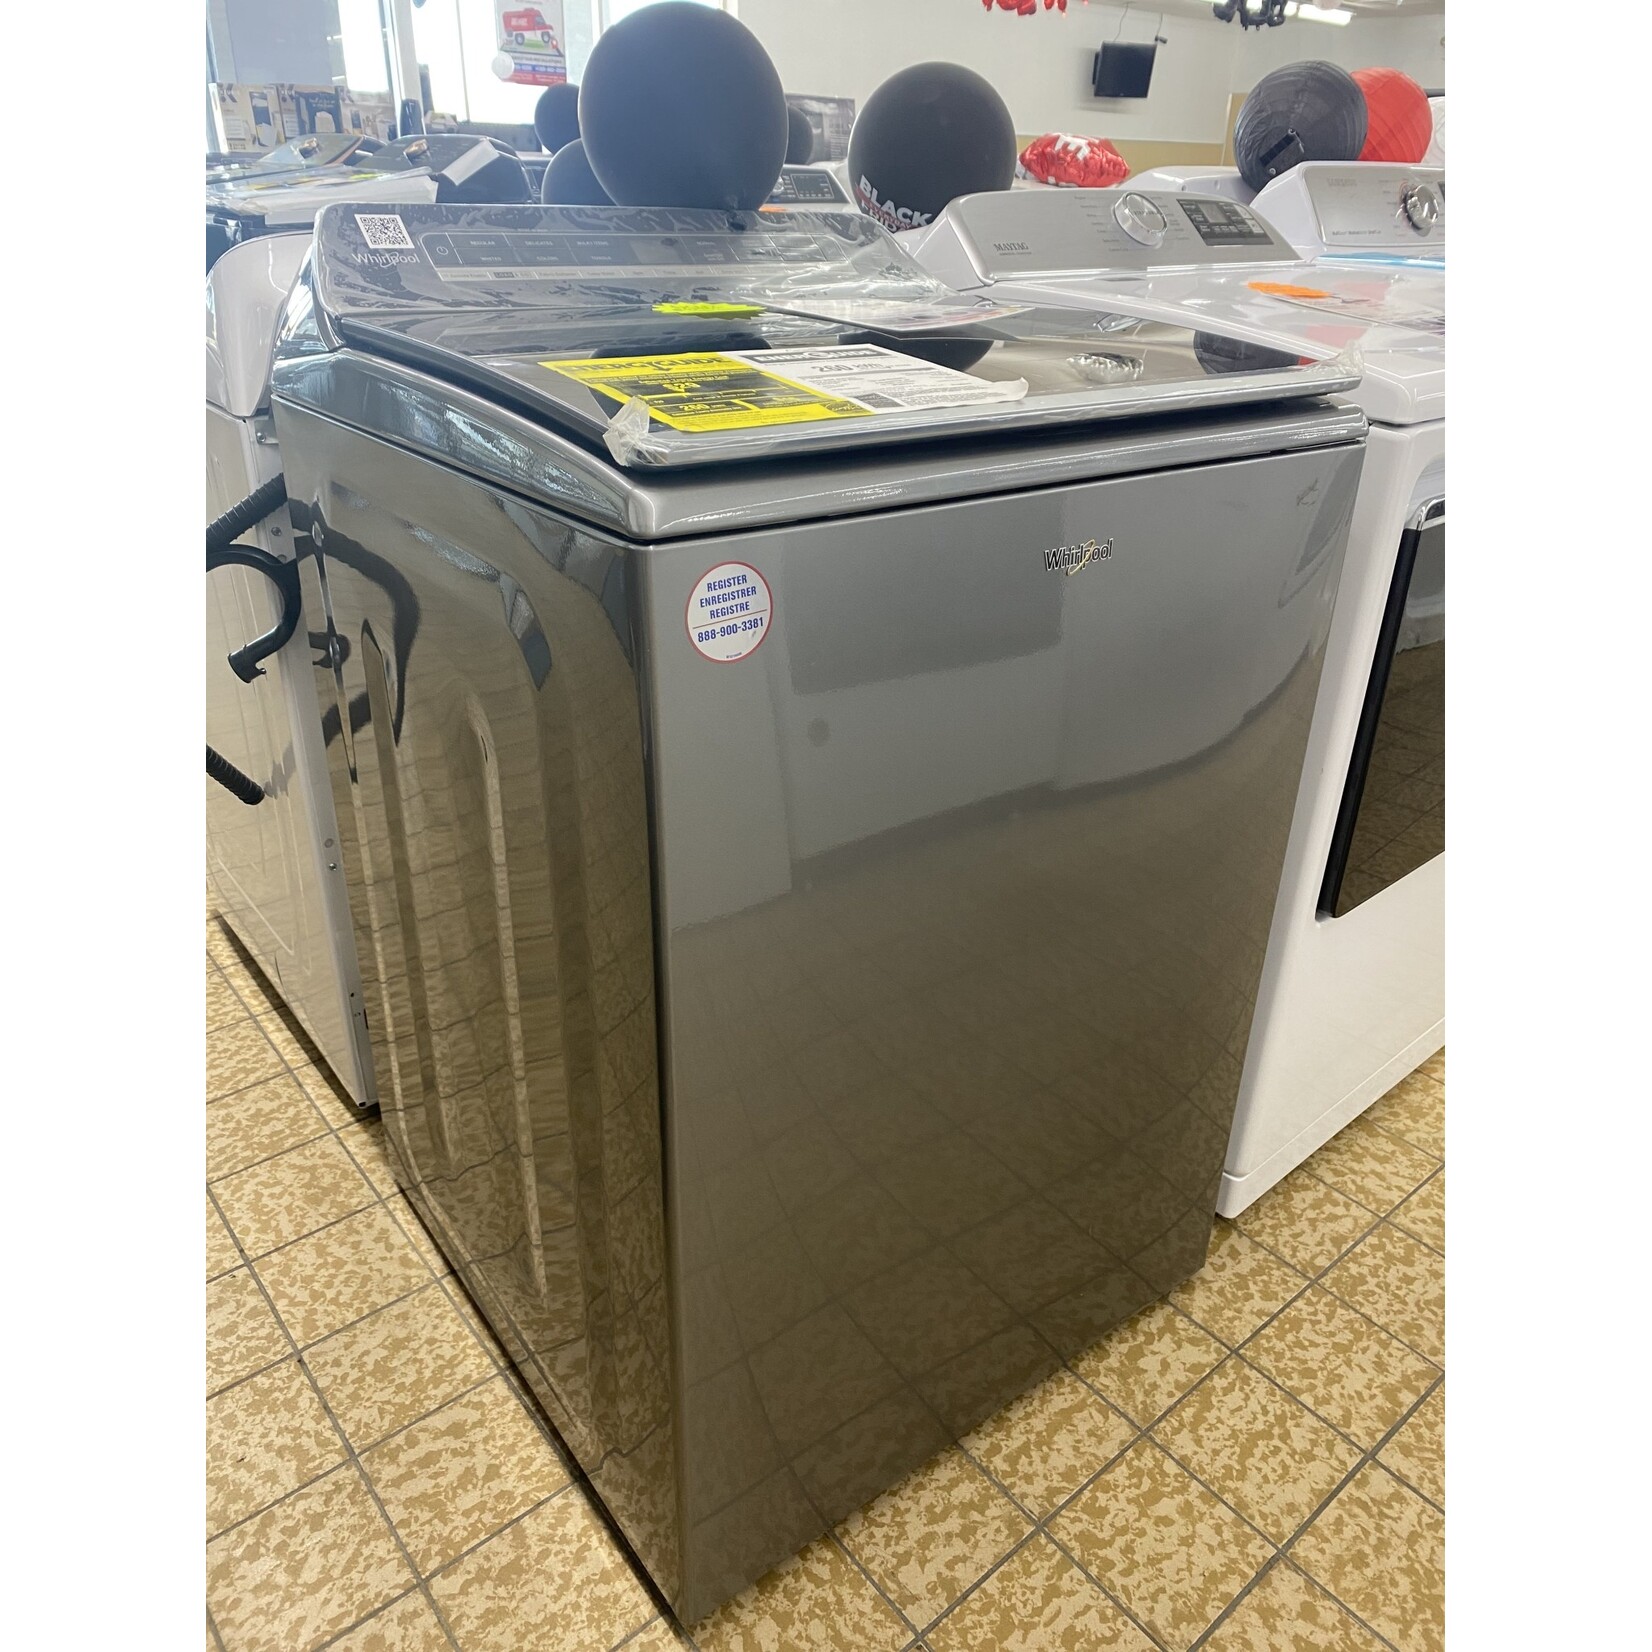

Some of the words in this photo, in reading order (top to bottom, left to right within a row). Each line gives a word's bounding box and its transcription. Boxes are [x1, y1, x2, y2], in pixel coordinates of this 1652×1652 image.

[860, 174, 933, 227] BLACK
[993, 242, 1029, 251] MAYTAG
[351, 251, 420, 267] Whirlpool
[1044, 538, 1114, 573] Whirlpool
[707, 574, 748, 592] REGISTER
[699, 586, 757, 608] ENREGISTRER
[709, 601, 750, 619] REGISTRE
[697, 616, 764, 643] 888-900-3381
